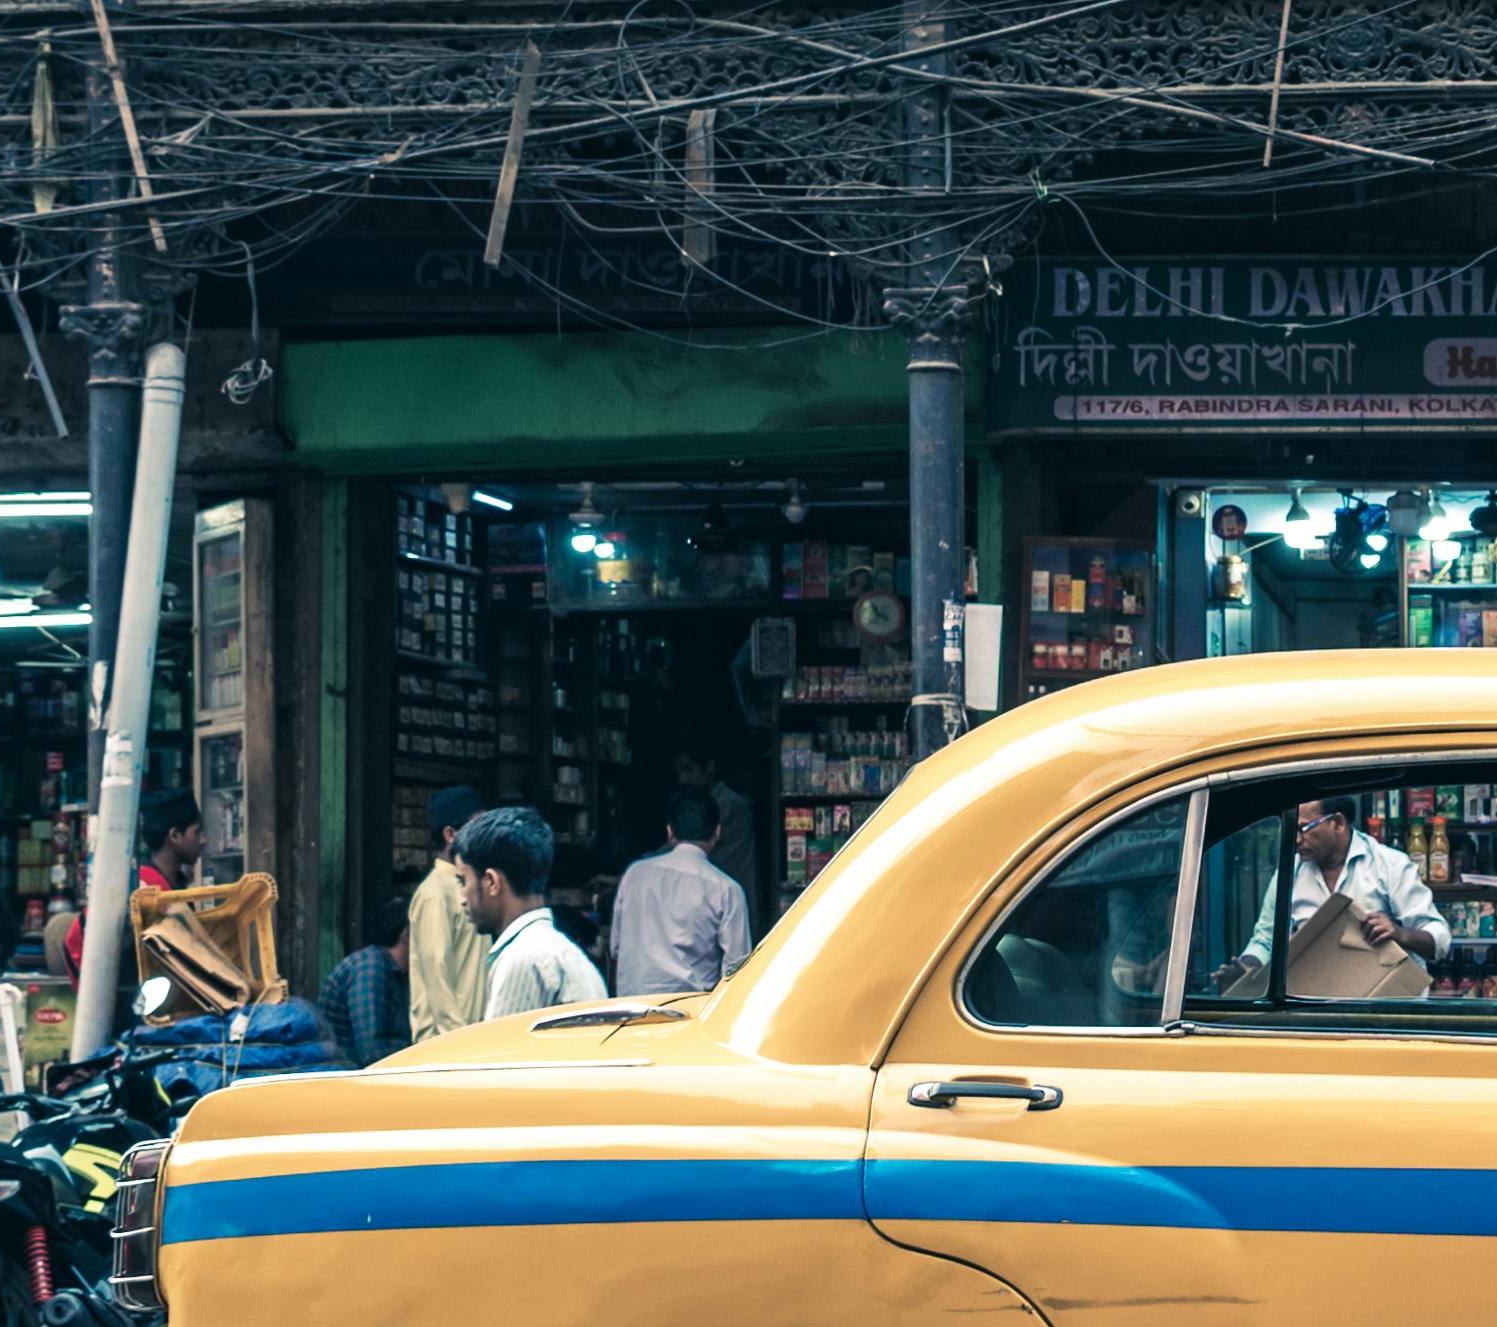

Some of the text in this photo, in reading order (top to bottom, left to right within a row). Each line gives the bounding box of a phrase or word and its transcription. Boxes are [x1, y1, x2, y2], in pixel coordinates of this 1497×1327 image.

[1052, 266, 1227, 318] DELHI
[1013, 325, 1118, 387] দিল্লী
[1082, 398, 1151, 416] 117/6,
[1158, 397, 1288, 414] RABINDRA
[1297, 396, 1401, 415] SARANI,
